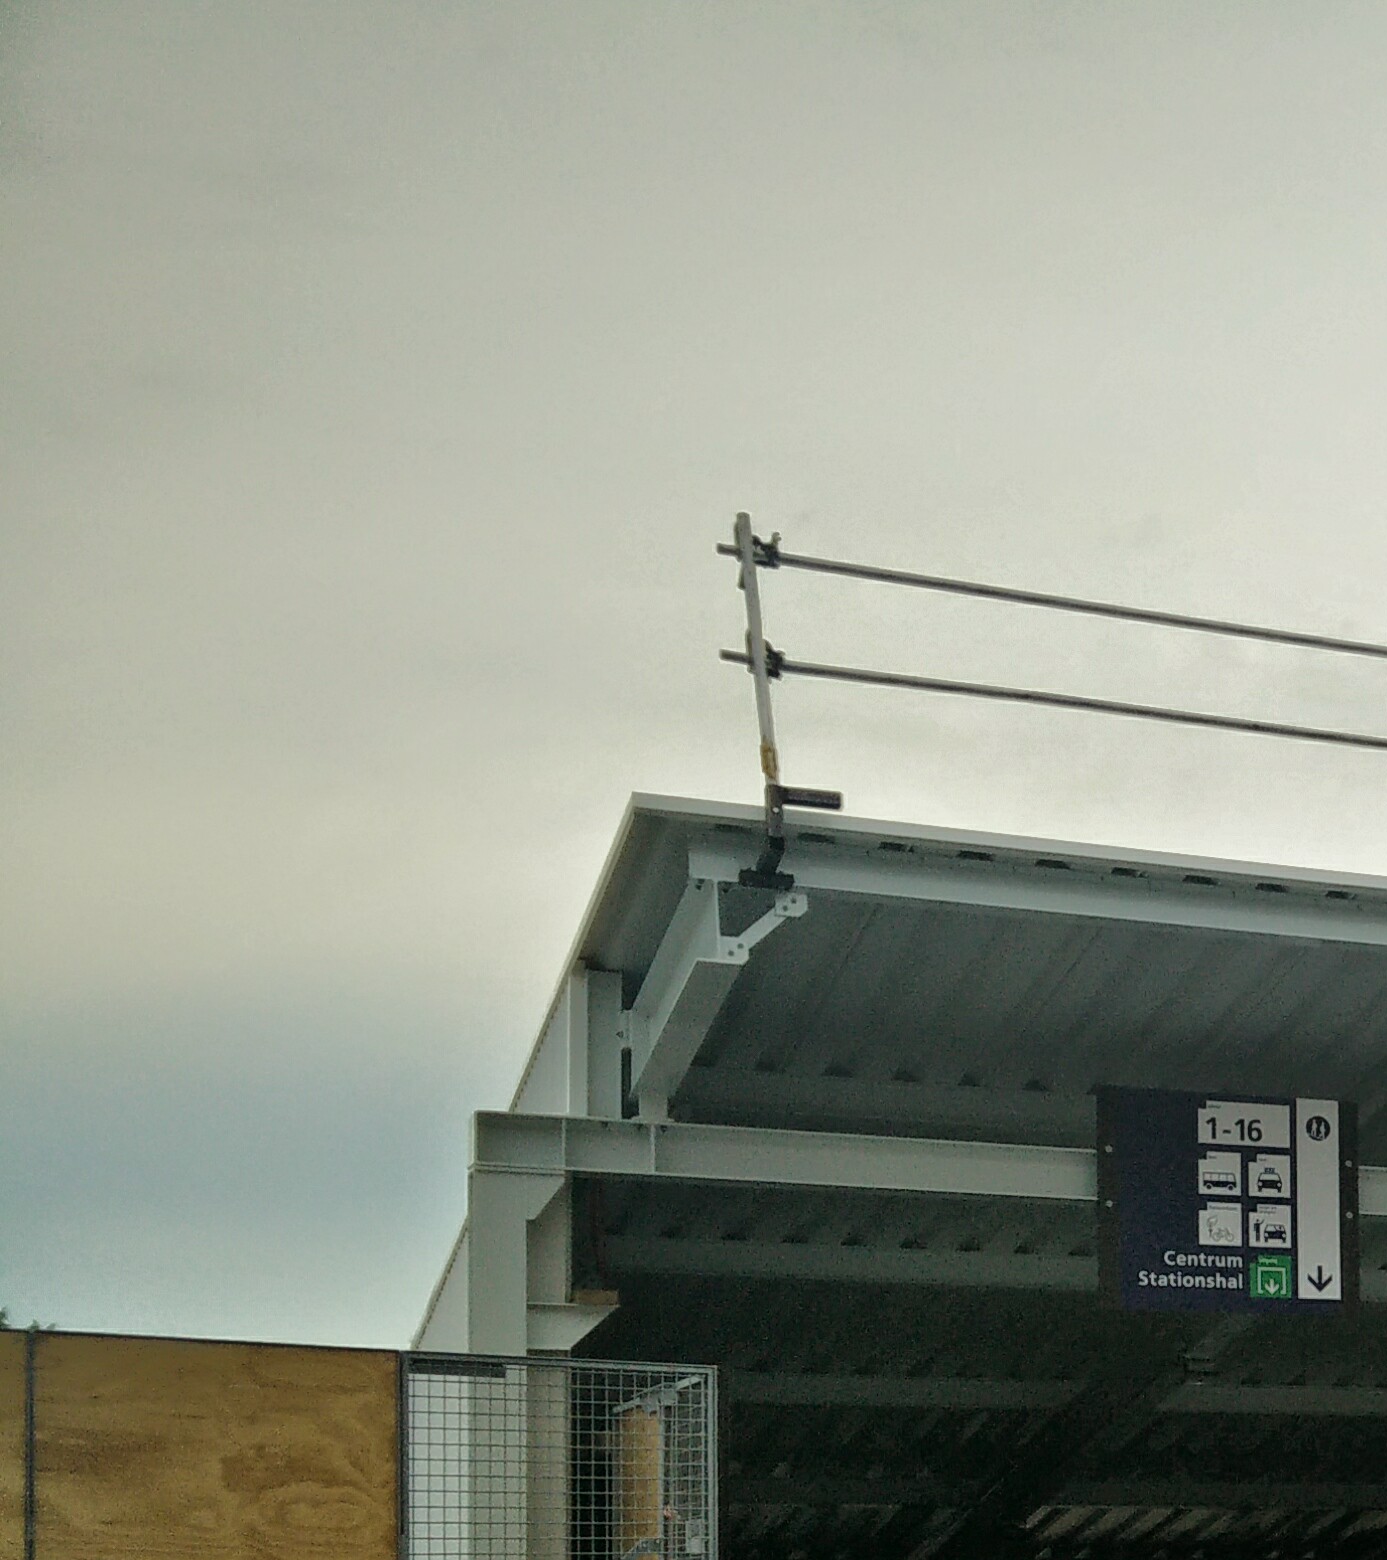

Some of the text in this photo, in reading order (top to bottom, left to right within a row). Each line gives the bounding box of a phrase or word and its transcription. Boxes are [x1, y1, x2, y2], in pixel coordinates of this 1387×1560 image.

[1205, 1116, 1263, 1142] 1-16
[1163, 1250, 1244, 1269] Centrum
[1137, 1270, 1244, 1290] Stationshal
